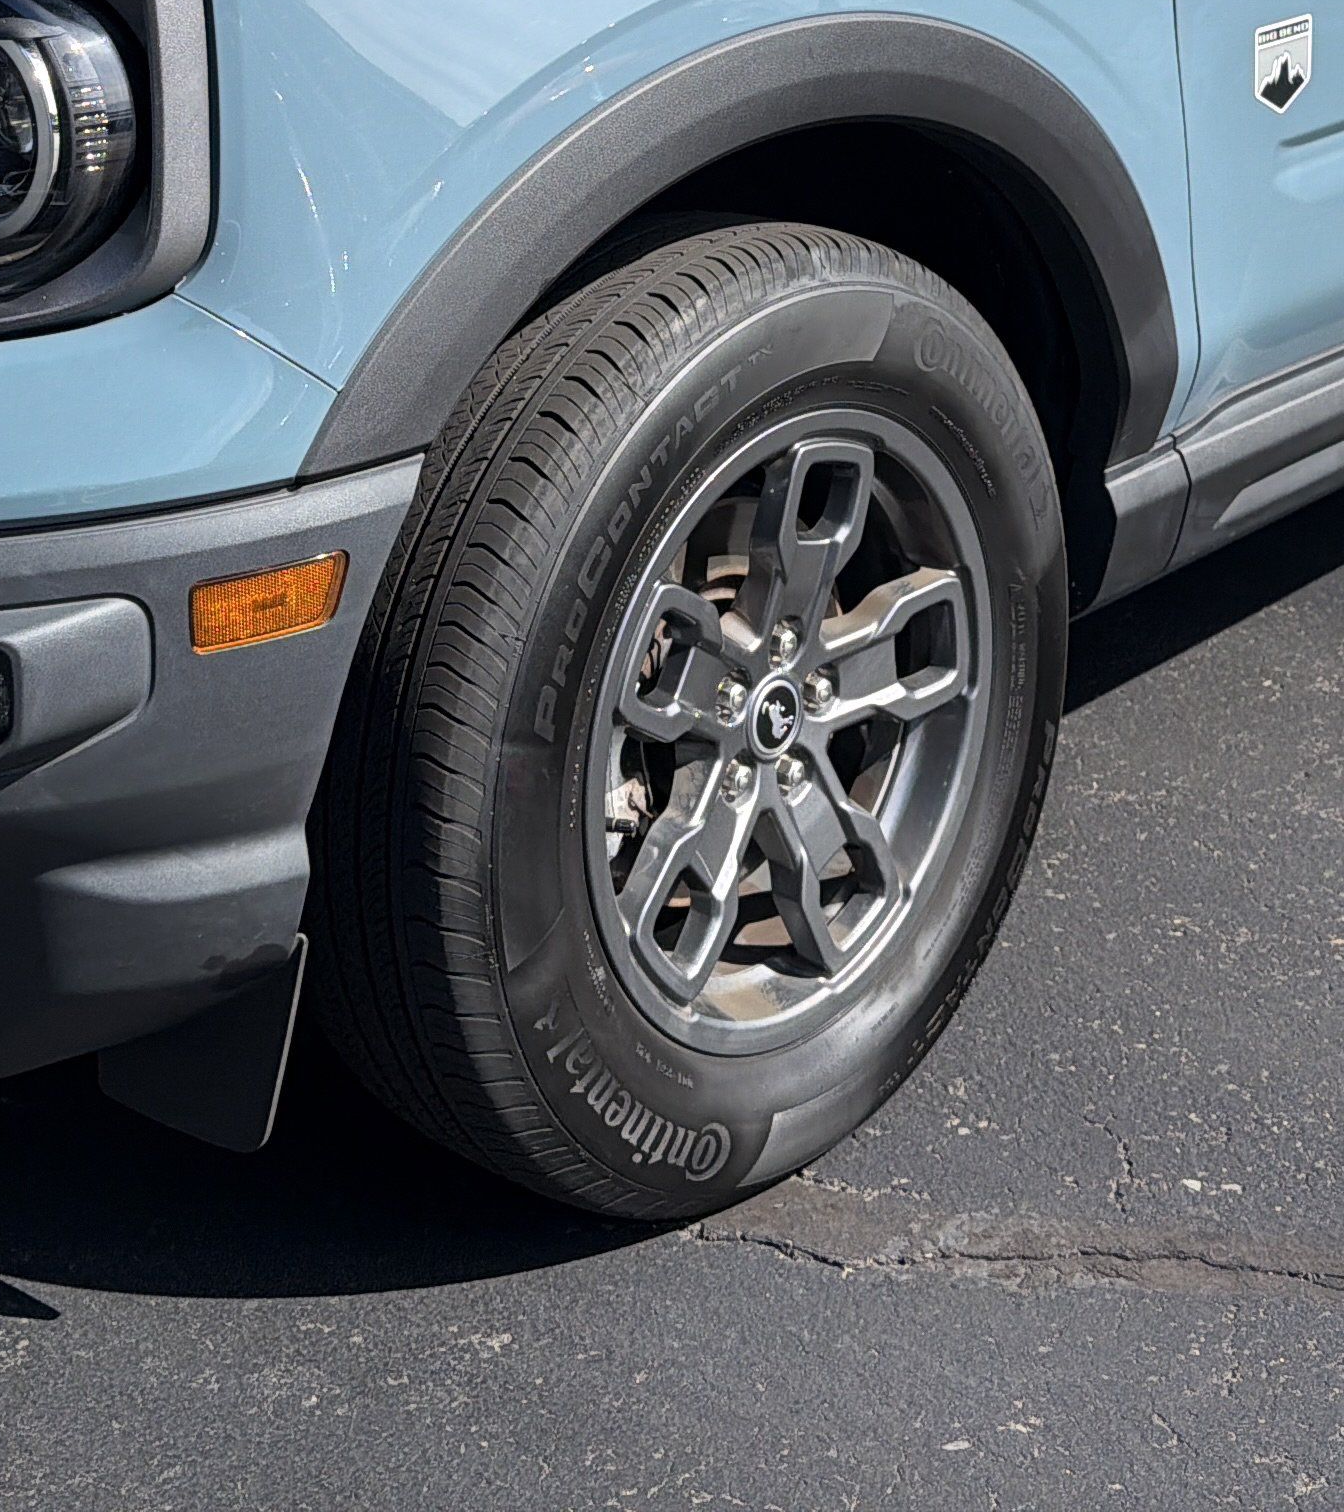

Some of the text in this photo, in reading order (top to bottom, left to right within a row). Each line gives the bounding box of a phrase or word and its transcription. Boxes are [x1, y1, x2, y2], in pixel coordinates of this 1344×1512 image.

[1258, 22, 1308, 44] BIG BEND
[546, 1027, 732, 1182] Continental
